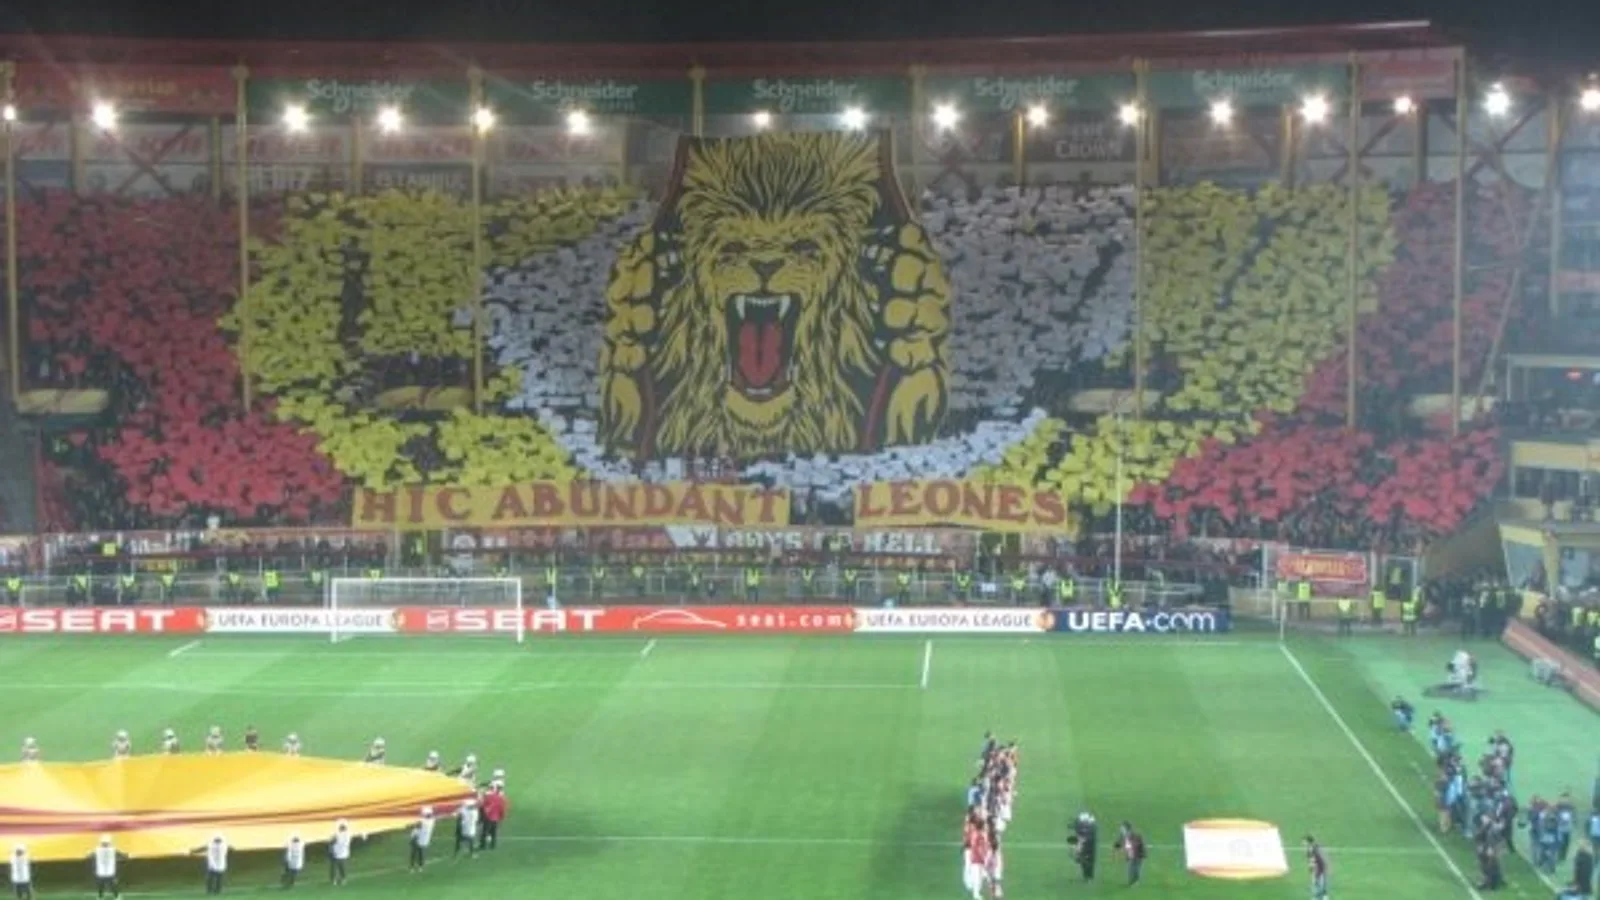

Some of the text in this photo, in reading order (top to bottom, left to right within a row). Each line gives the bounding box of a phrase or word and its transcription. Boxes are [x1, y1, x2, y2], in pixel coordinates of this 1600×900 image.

[306, 79, 413, 112] Schneider
[532, 79, 638, 112] Schneider
[752, 78, 858, 112] Schneider
[973, 76, 1079, 111] Schneider
[361, 480, 785, 526] HIC ABUNDANT
[856, 480, 1068, 525] LEONES
[21, 609, 175, 633] SEAT
[218, 613, 383, 628] UEFA EUROPA LEAGUE
[455, 609, 606, 632] SEAT
[736, 613, 842, 628] seat.com
[866, 614, 1032, 628] UEFA EUROPA LEAGUE
